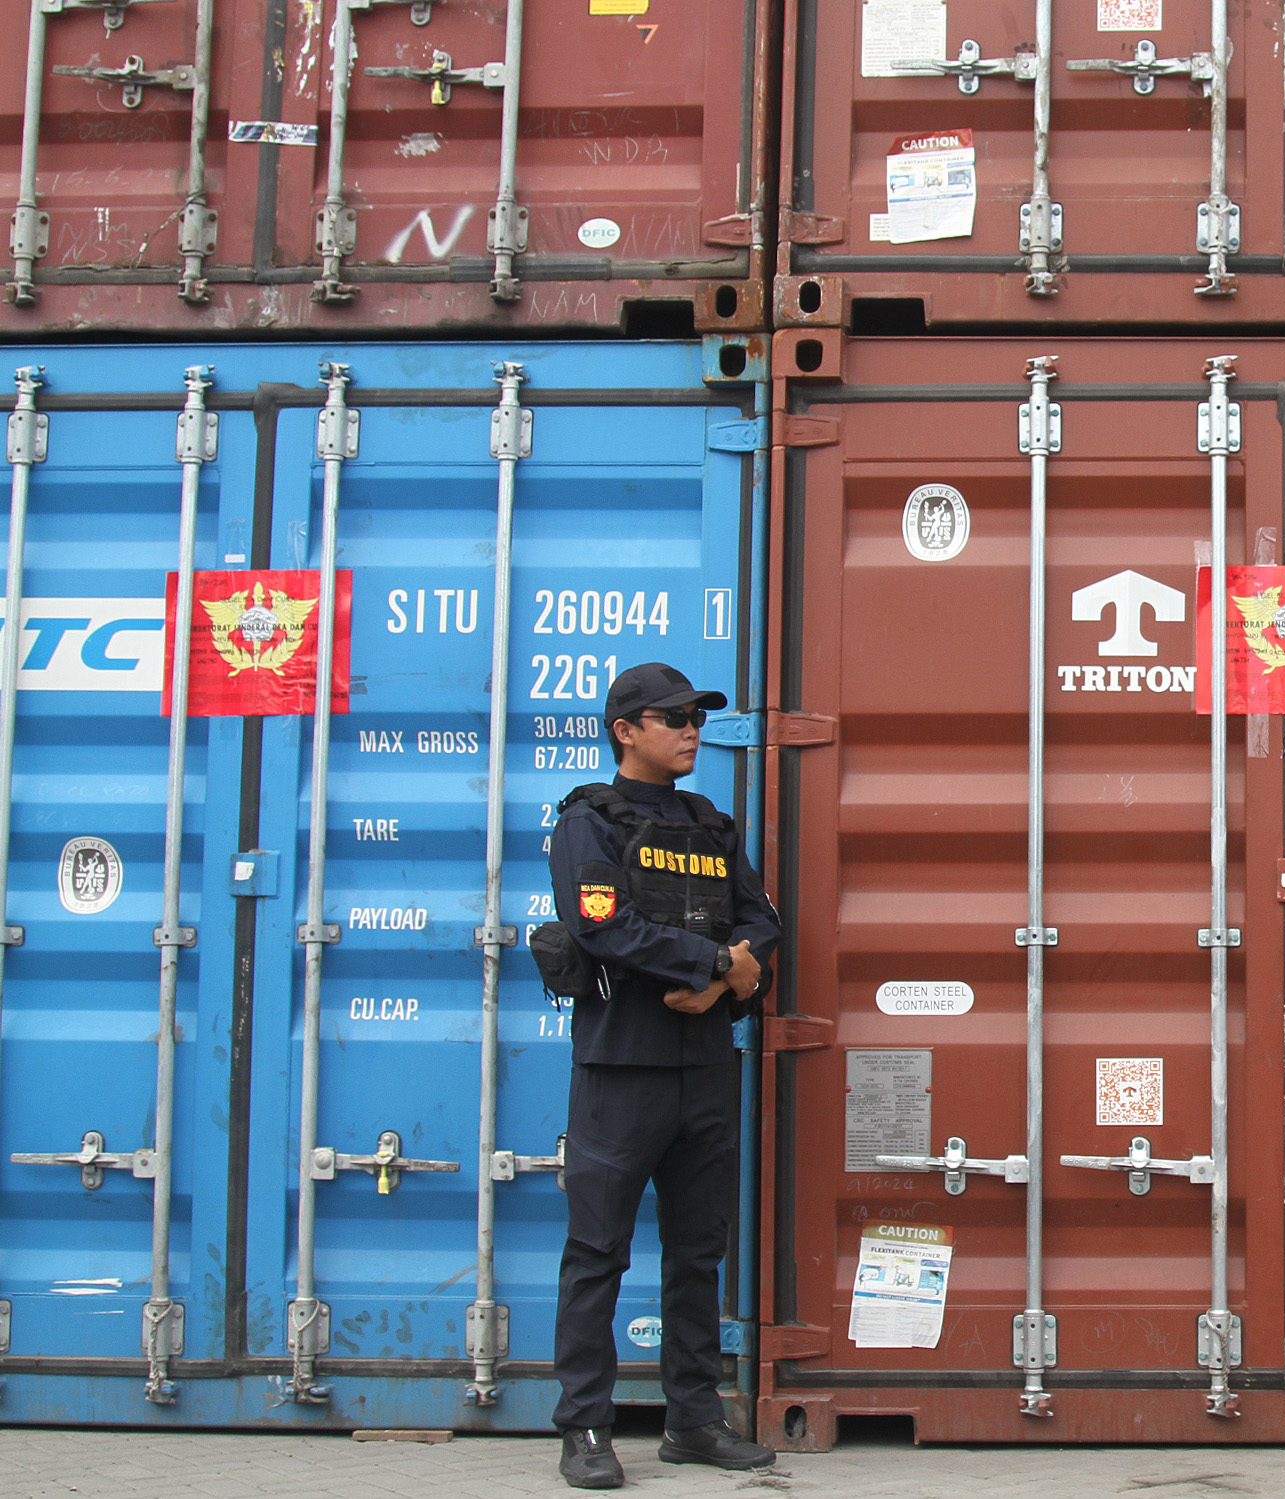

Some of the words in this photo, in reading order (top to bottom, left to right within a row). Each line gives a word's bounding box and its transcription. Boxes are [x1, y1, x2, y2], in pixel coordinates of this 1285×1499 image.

[902, 136, 959, 150] CAUTION
[582, 229, 616, 237] DFIC
[909, 489, 933, 526] BUREAU
[938, 489, 964, 526] VERITAS
[387, 589, 479, 634] SITU
[533, 590, 670, 636] 260944
[0, 618, 165, 670] TC
[530, 655, 617, 699] 22G1
[1057, 665, 1197, 692] TRITON
[534, 716, 599, 739] 30,480
[359, 730, 404, 754] MAX
[417, 731, 479, 754] GROSS
[534, 747, 600, 770] 67,200
[353, 819, 399, 842] TARE
[64, 841, 86, 877] BUREAU
[90, 842, 117, 878] VERITAS
[639, 846, 727, 878] CUSTOMS
[349, 908, 428, 930] PAYLOAD
[884, 986, 929, 997] CORTEN
[934, 986, 967, 997] STEEL
[350, 998, 419, 1021] CU.CAP.
[895, 1000, 955, 1011] CONTAINER
[878, 1225, 939, 1241] CAUTION
[871, 1247, 905, 1255] FLEXITANK
[905, 1250, 940, 1258] CONTAINER
